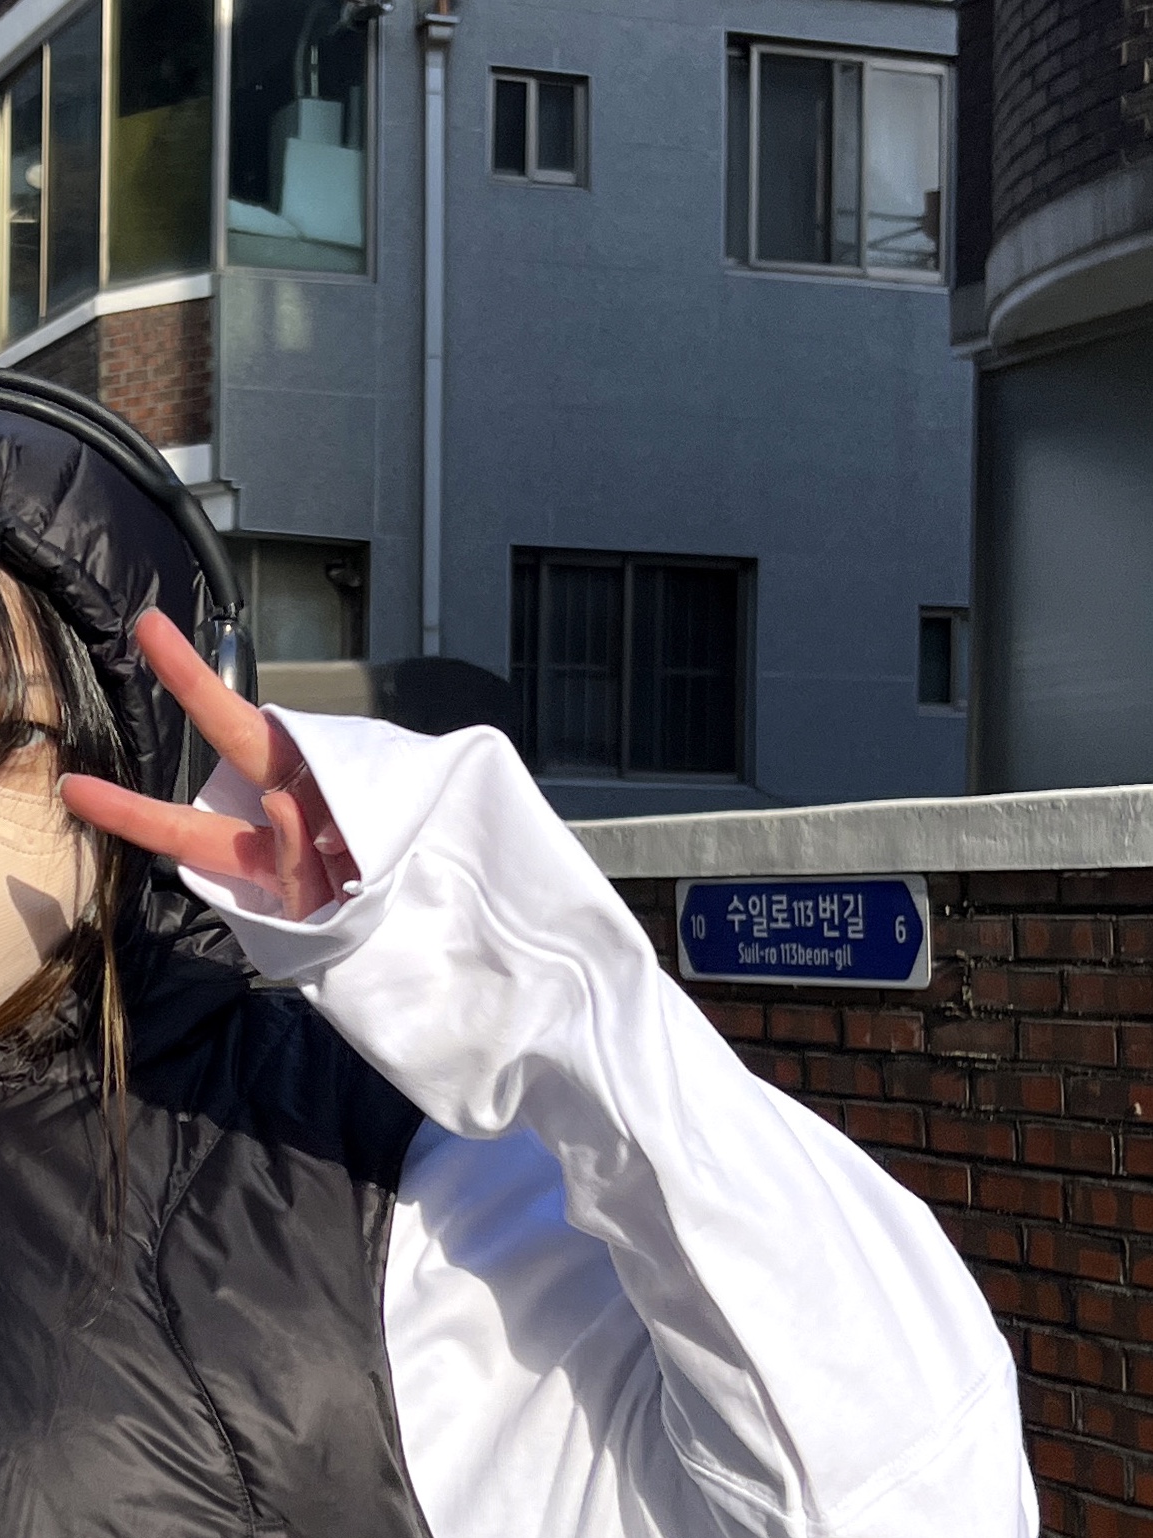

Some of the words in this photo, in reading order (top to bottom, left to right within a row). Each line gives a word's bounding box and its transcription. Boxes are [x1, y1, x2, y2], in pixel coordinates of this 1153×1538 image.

[690, 914, 706, 940] 10
[726, 893, 864, 939] 수일로113번길
[895, 915, 906, 944] 6
[738, 942, 777, 965] Suil-ro
[780, 943, 852, 971] 113beon-gil
